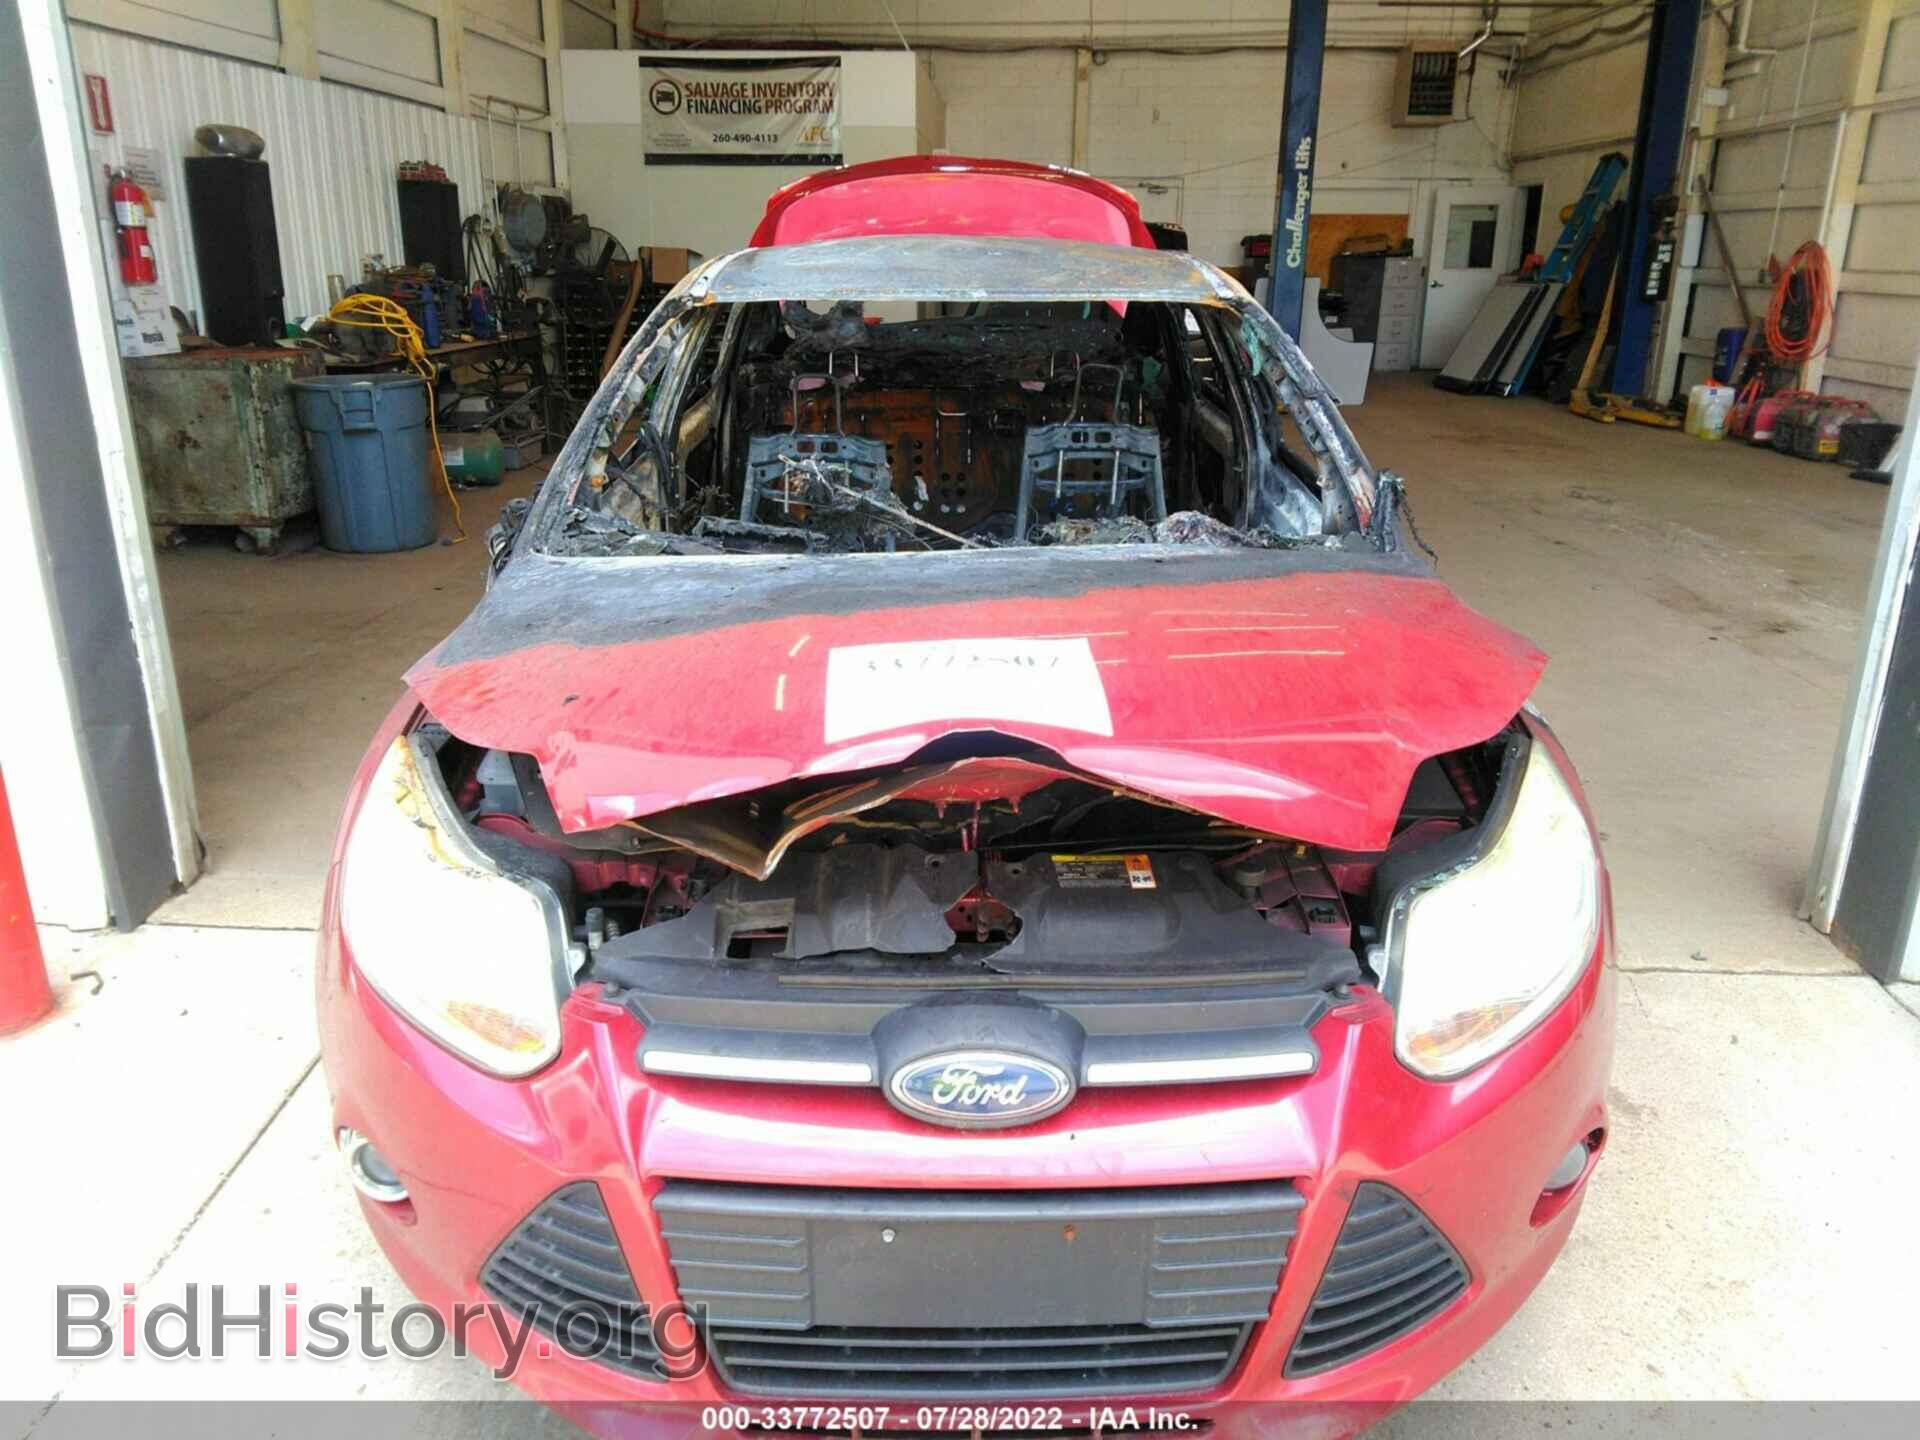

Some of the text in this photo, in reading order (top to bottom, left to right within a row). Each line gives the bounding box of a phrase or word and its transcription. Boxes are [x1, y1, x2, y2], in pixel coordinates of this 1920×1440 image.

[684, 81, 835, 99] SALVAGE INVENTORY
[687, 98, 834, 115] FINANCING PROGRAM
[712, 133, 779, 144] 260-490-4113
[1285, 136, 1312, 268] Challenger Lifts
[932, 1063, 1028, 1105] Ford
